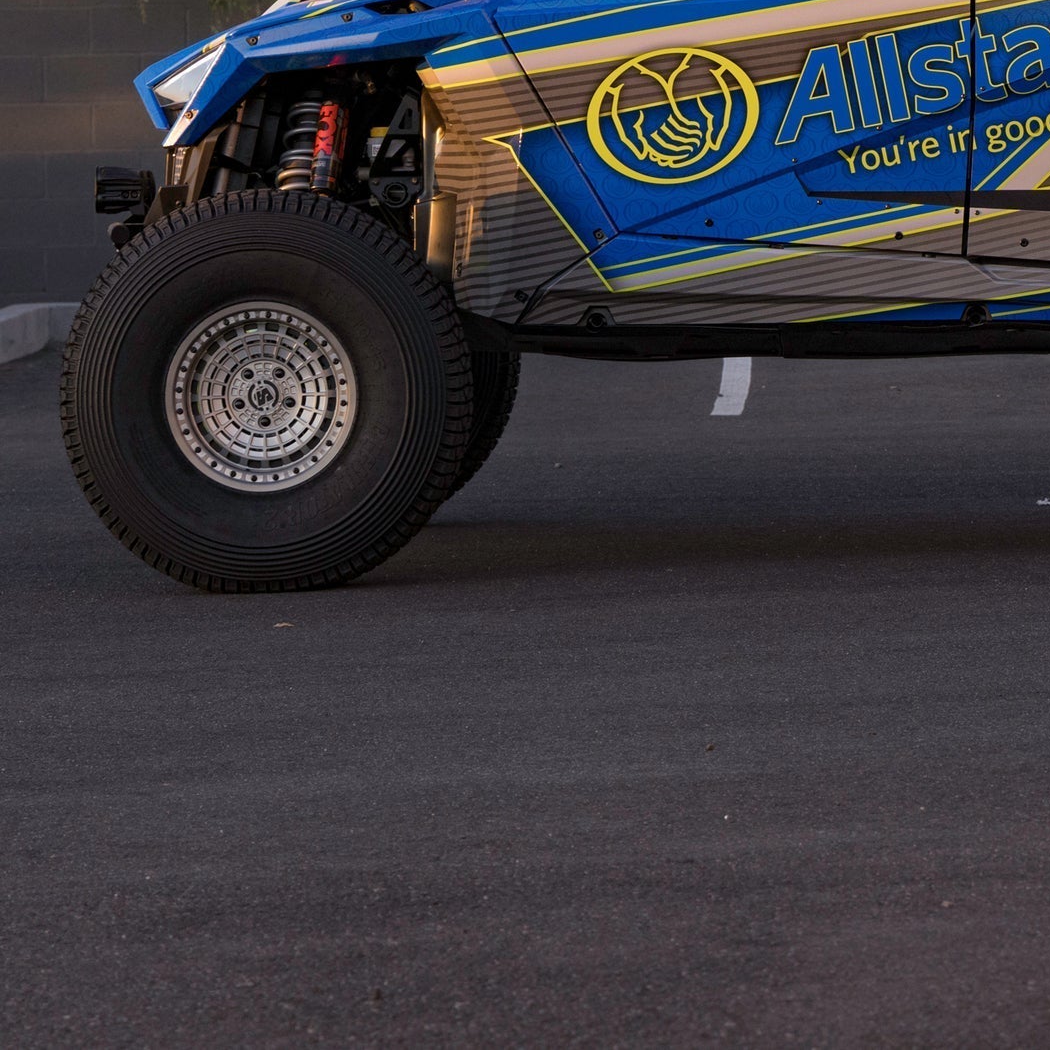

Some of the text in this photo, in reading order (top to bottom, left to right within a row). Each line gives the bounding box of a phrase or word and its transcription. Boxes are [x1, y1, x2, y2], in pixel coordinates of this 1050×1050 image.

[313, 104, 339, 158] FOX
[838, 136, 941, 175] You're
[947, 124, 977, 154] in
